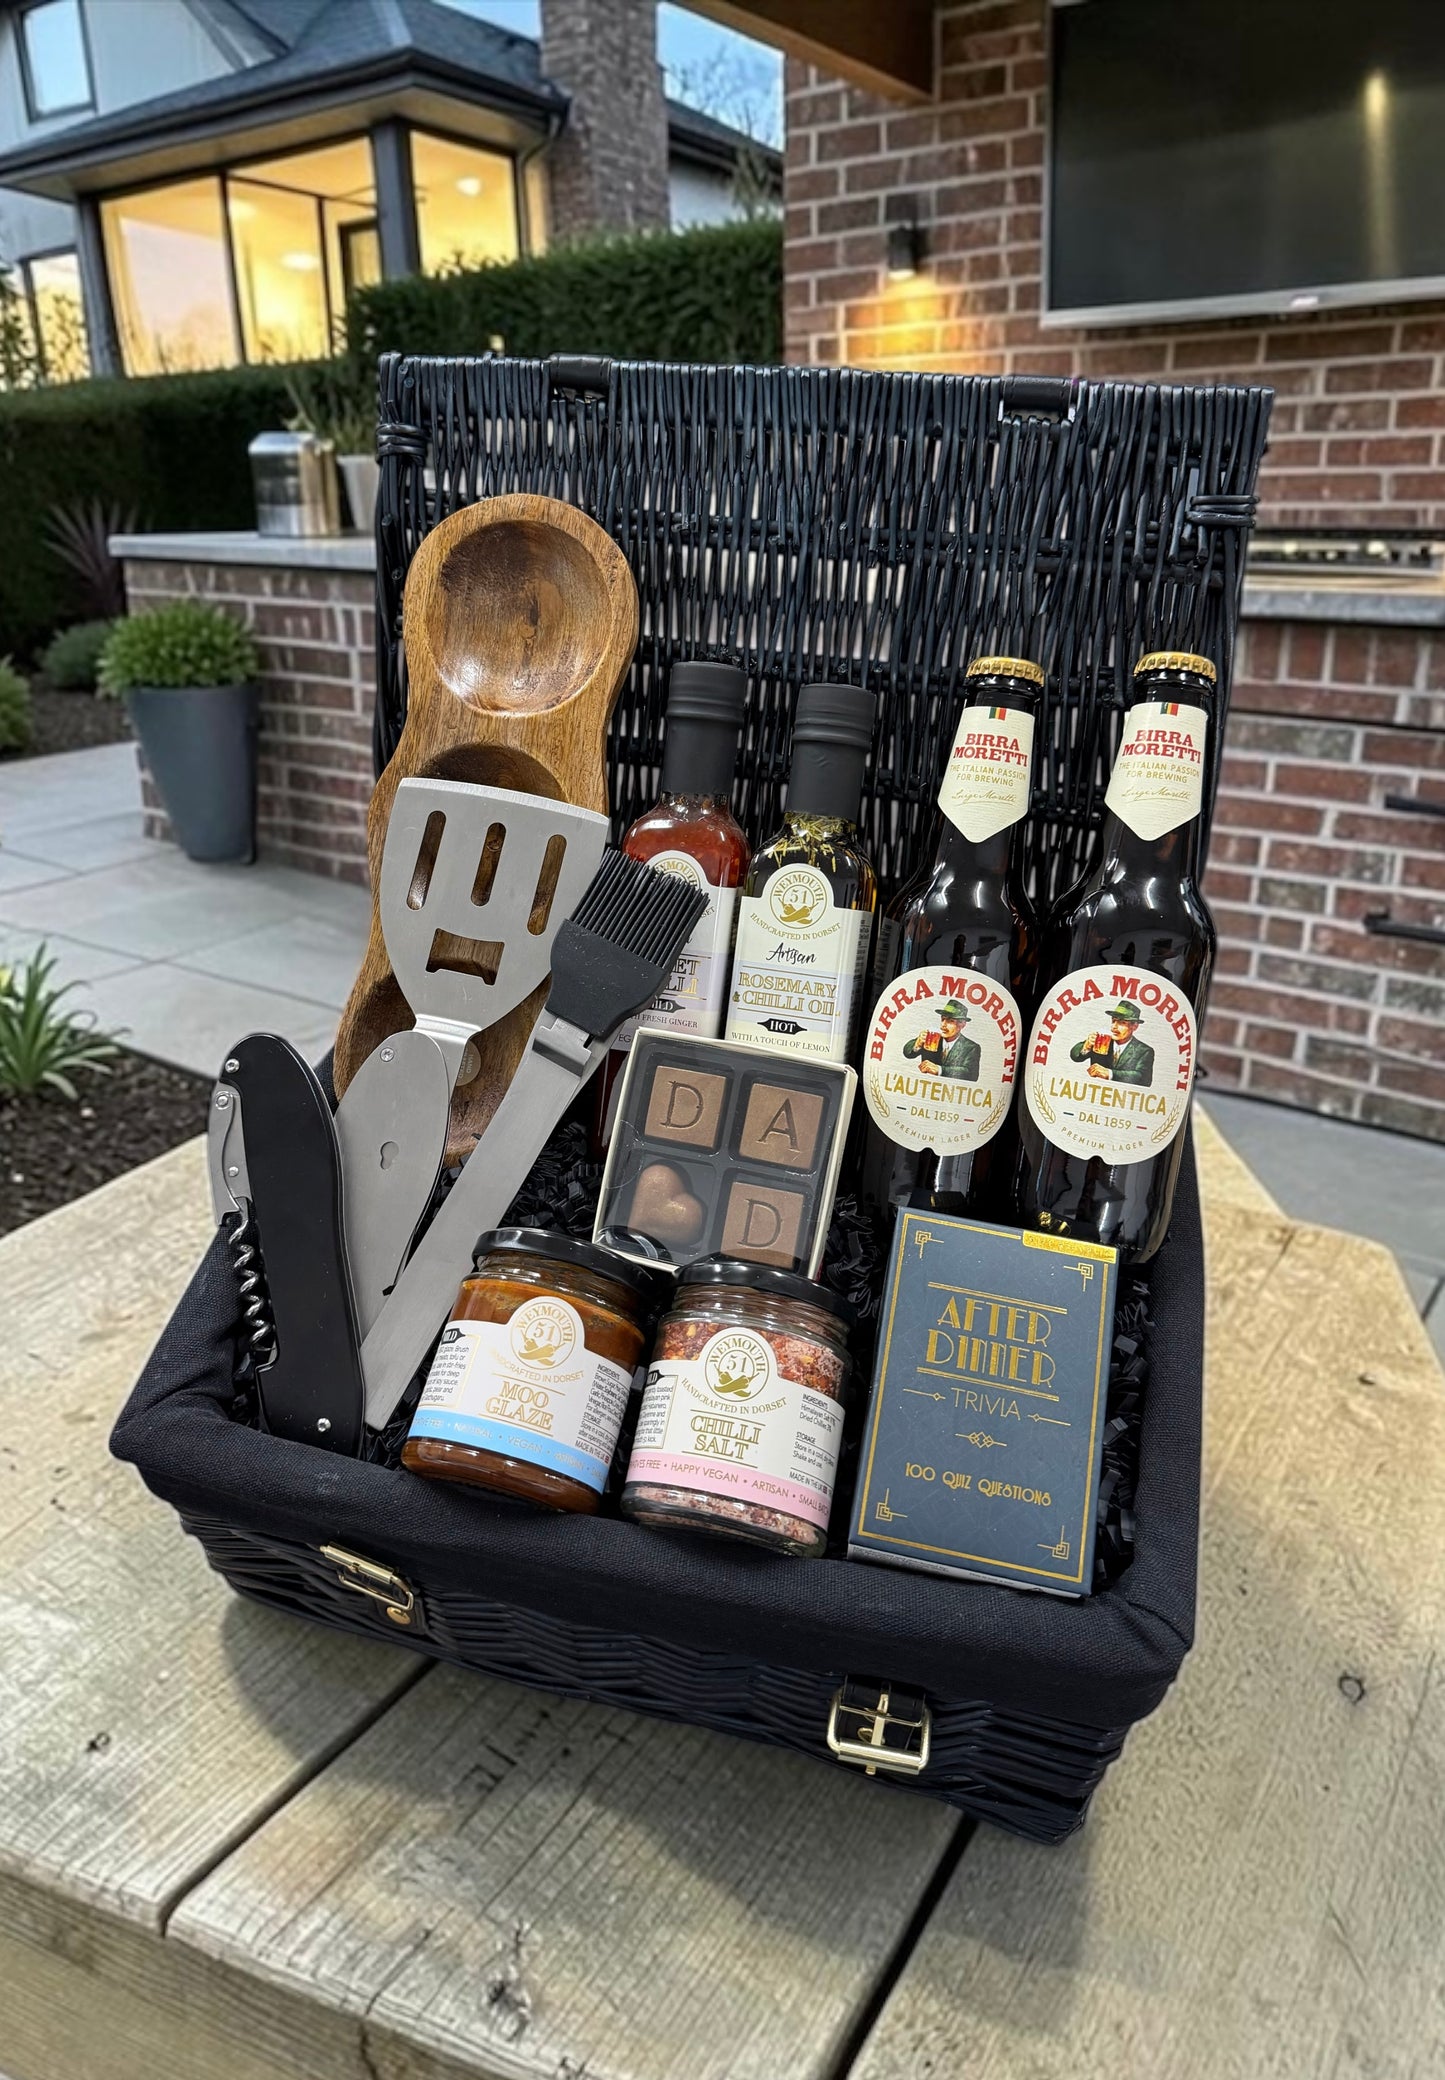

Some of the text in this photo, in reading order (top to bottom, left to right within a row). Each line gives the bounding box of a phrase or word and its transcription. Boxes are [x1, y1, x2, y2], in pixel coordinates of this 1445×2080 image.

[965, 733, 1020, 751] BIRRA
[1135, 729, 1193, 747] BIRRA
[953, 746, 1028, 767] MORETTI
[1118, 762, 1131, 770] THE
[1132, 762, 1167, 771] ITALIAN
[1122, 743, 1201, 764] MORETTI
[950, 764, 1027, 781] THE ITALIAN PASSION
[956, 773, 1014, 787] FOR BREWING
[1126, 770, 1188, 784] FOR BREWING
[654, 860, 698, 887] EYMOUTH
[774, 873, 825, 902] WEYMOUTH
[789, 888, 808, 904] 51
[750, 912, 842, 940] HANDCRAFTED IN DORSET
[766, 942, 817, 965] Artisan
[738, 971, 837, 999] ROSEMARY
[732, 990, 841, 1017] & CHILLI OIL
[642, 1013, 668, 1024] FRESH
[668, 1018, 699, 1029] GINGER
[769, 1020, 797, 1034] HOT
[870, 978, 935, 1062] BIRRA
[939, 975, 1017, 1084] MORETTI
[1033, 975, 1193, 1092] BIRRA MORETTI
[731, 1031, 753, 1040] WITH
[759, 1036, 788, 1047] TOUCH
[789, 1040, 801, 1049] OF
[802, 1042, 831, 1053] LEMON
[884, 1072, 993, 1109] L'AUTENTICA
[1049, 1077, 1167, 1117] L'AUTENTICA
[660, 1080, 801, 1154] D A
[910, 1105, 960, 1124] DAL 1859
[1078, 1111, 1133, 1131] DAL 1859
[894, 1119, 972, 1144] PREMIUM LAGER
[1060, 1125, 1144, 1152] PREMIUM LAGER
[737, 1198, 783, 1249] D
[516, 1305, 573, 1342] WEYMOUTH
[533, 1321, 556, 1342] 51
[937, 1295, 1053, 1348] AFTER
[709, 1337, 766, 1372] WEYMOUTH
[726, 1354, 747, 1373] 51
[925, 1328, 1057, 1388] DINNER
[543, 1375, 551, 1383] IN
[553, 1370, 585, 1383] DORSET
[499, 1380, 549, 1409] MOO
[681, 1377, 788, 1415] HANDCRAFTED IN DORSET
[951, 1386, 1022, 1422] TRIVIA
[485, 1396, 554, 1431] GLAZE
[690, 1415, 762, 1445] CHILLI
[508, 1435, 543, 1453] VEGAN
[694, 1434, 749, 1460] SALT
[794, 1441, 807, 1454] Store
[670, 1462, 701, 1475] HAPPY
[702, 1466, 739, 1484] VEGAN
[751, 1480, 789, 1498] ARTISAN
[799, 1494, 818, 1511] SMALL
[789, 1471, 805, 1484] MADE
[905, 1462, 1052, 1507] 100 QUIZ QUESTIONS
